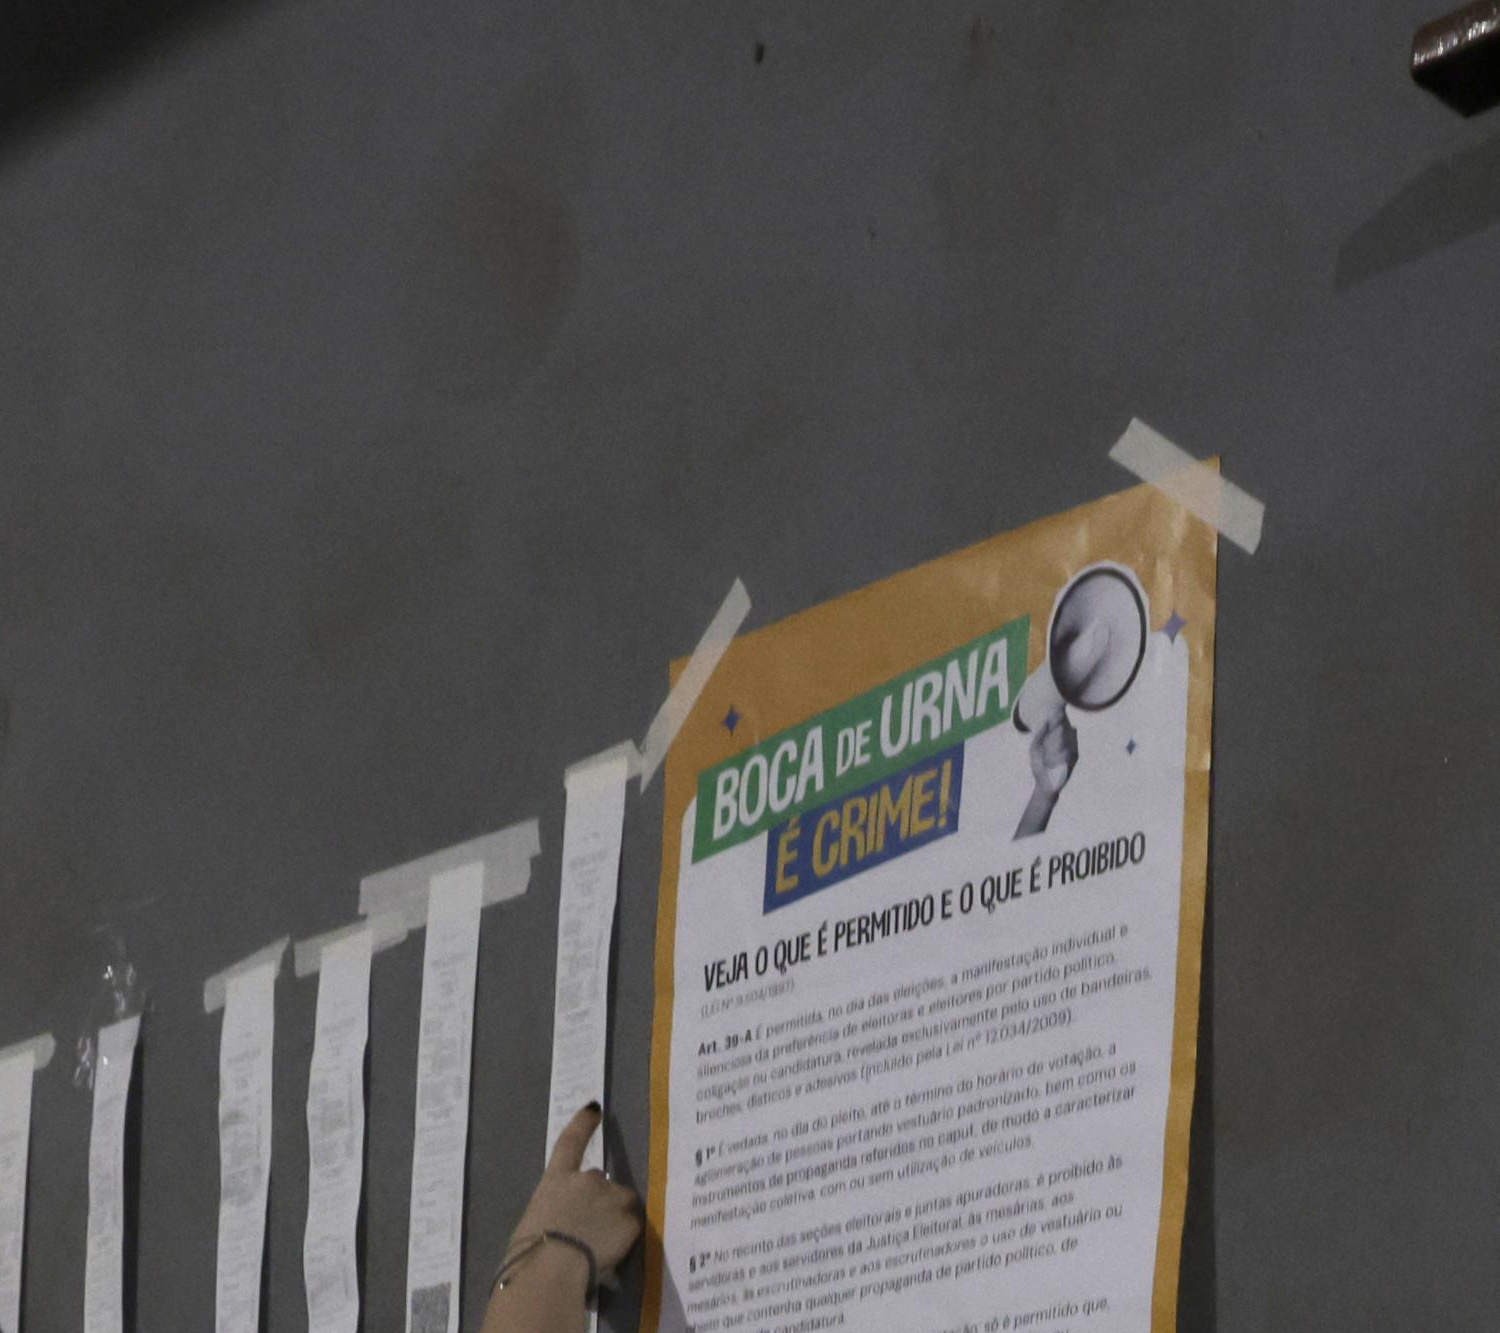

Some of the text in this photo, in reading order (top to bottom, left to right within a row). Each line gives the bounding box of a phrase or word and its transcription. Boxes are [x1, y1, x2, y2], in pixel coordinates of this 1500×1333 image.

[711, 640, 1010, 843] BOCA DE URNA
[775, 758, 954, 893] É CRIME!
[704, 832, 1147, 992] VEJA O QUE É PERMITIDO E O QUE É PROIBIDO
